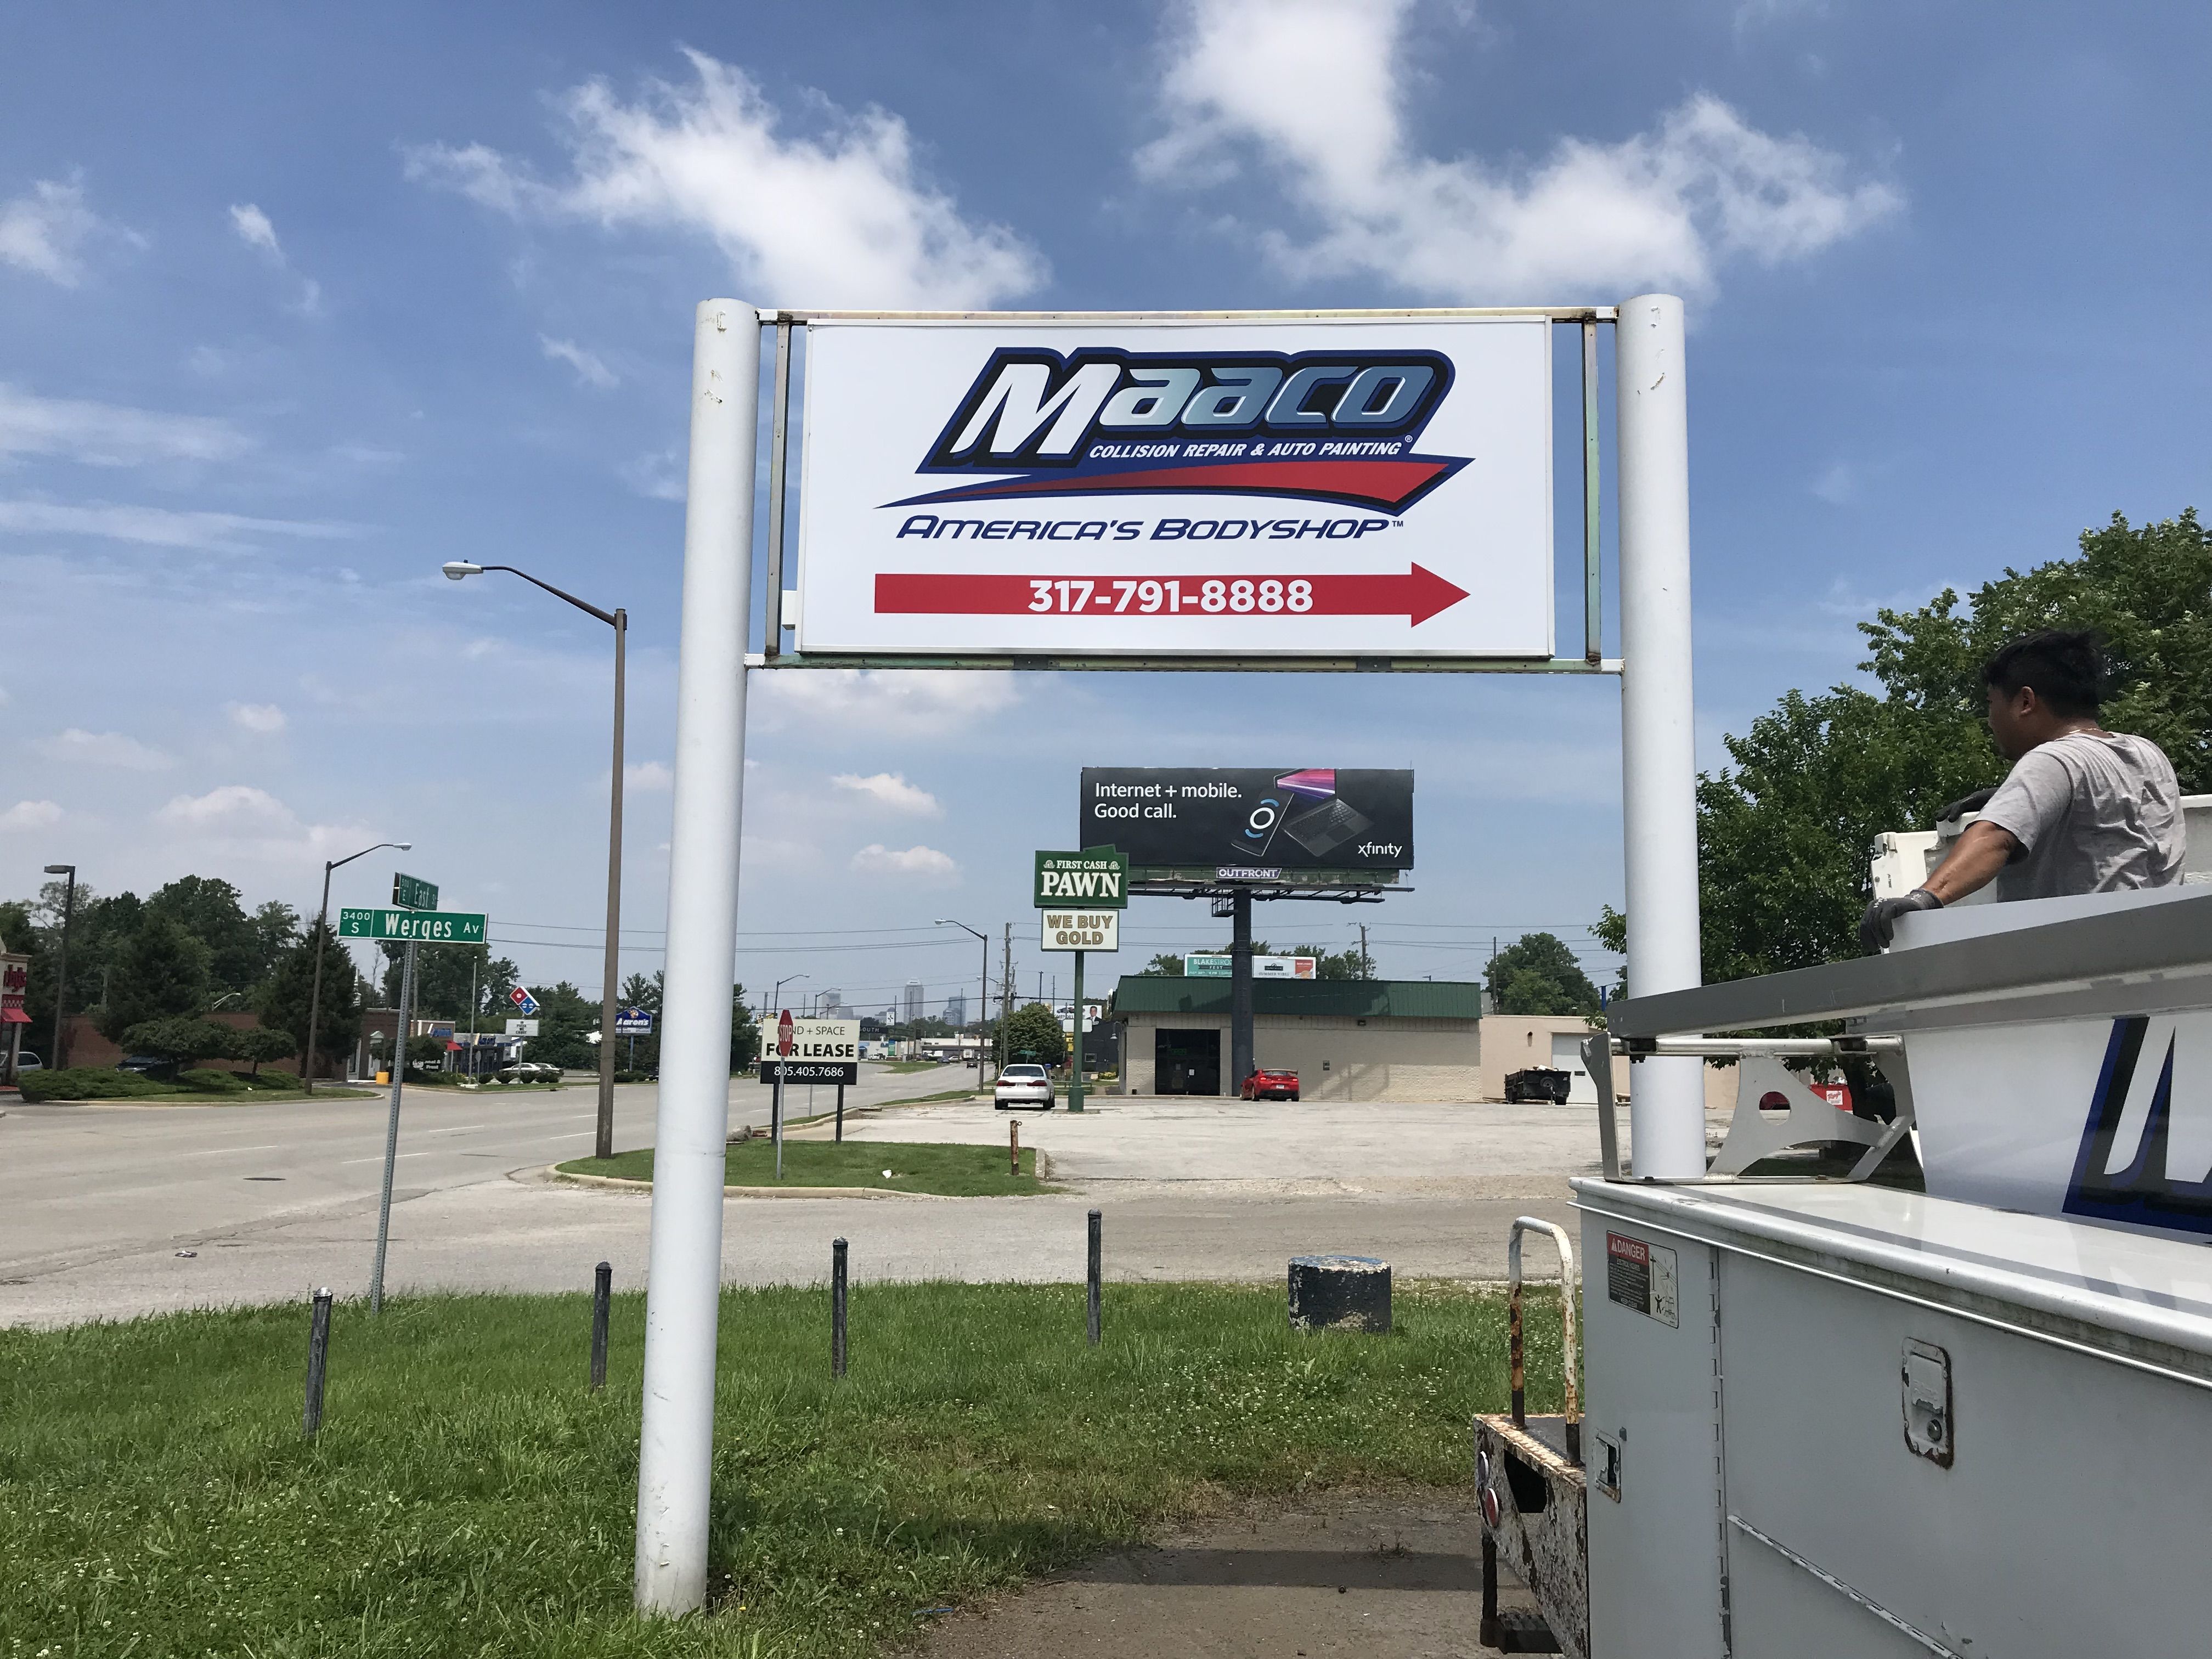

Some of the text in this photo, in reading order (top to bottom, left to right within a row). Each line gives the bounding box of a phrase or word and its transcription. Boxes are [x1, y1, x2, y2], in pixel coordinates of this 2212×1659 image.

[946, 362, 1437, 456] Maaco
[1090, 442, 1402, 458] COLLISION REPAIR & AUTO PAINTING
[1028, 579, 1313, 613] 317-791-8888
[1095, 783, 1243, 798] Internet + mobile.
[1094, 803, 1177, 819] Good call.
[1358, 842, 1403, 858] xfinity
[1057, 860, 1107, 870] FIRST CASH
[1218, 868, 1280, 878] OUTFRONT
[1041, 871, 1121, 898] PAWN
[414, 883, 429, 908] East
[343, 911, 370, 921] 3400
[1047, 915, 1113, 929] WE BUY
[351, 922, 359, 933] S
[385, 913, 479, 940] Werges Av
[1056, 931, 1104, 945] GOLD
[780, 1024, 792, 1042] STOP
[816, 1026, 845, 1035] SPACE
[804, 1043, 854, 1057] LEASE
[1617, 1240, 1645, 1261] DANGER
